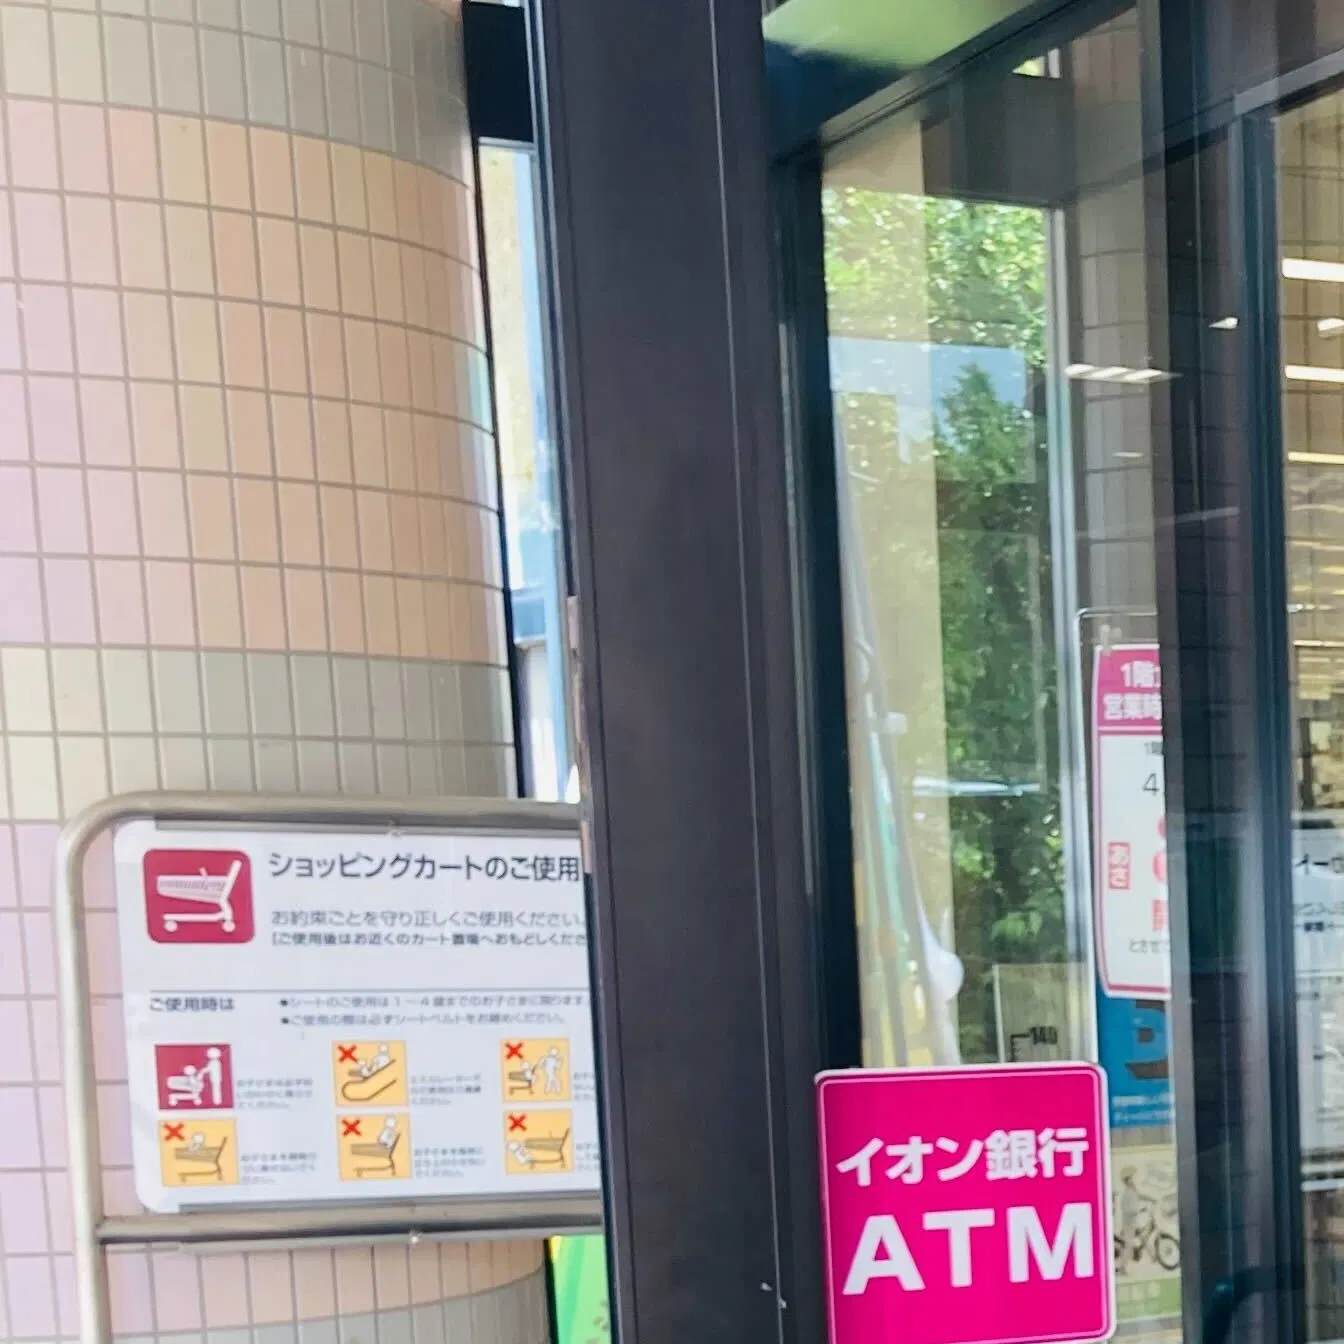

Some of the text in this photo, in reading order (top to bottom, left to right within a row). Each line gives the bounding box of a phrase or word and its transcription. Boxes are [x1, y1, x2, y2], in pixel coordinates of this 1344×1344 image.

[1120, 660, 1161, 689] 1階
[268, 851, 581, 882] ショッピングカートのご使用
[835, 1127, 1090, 1188] イオン銀行
[842, 1201, 1095, 1296] ATM
